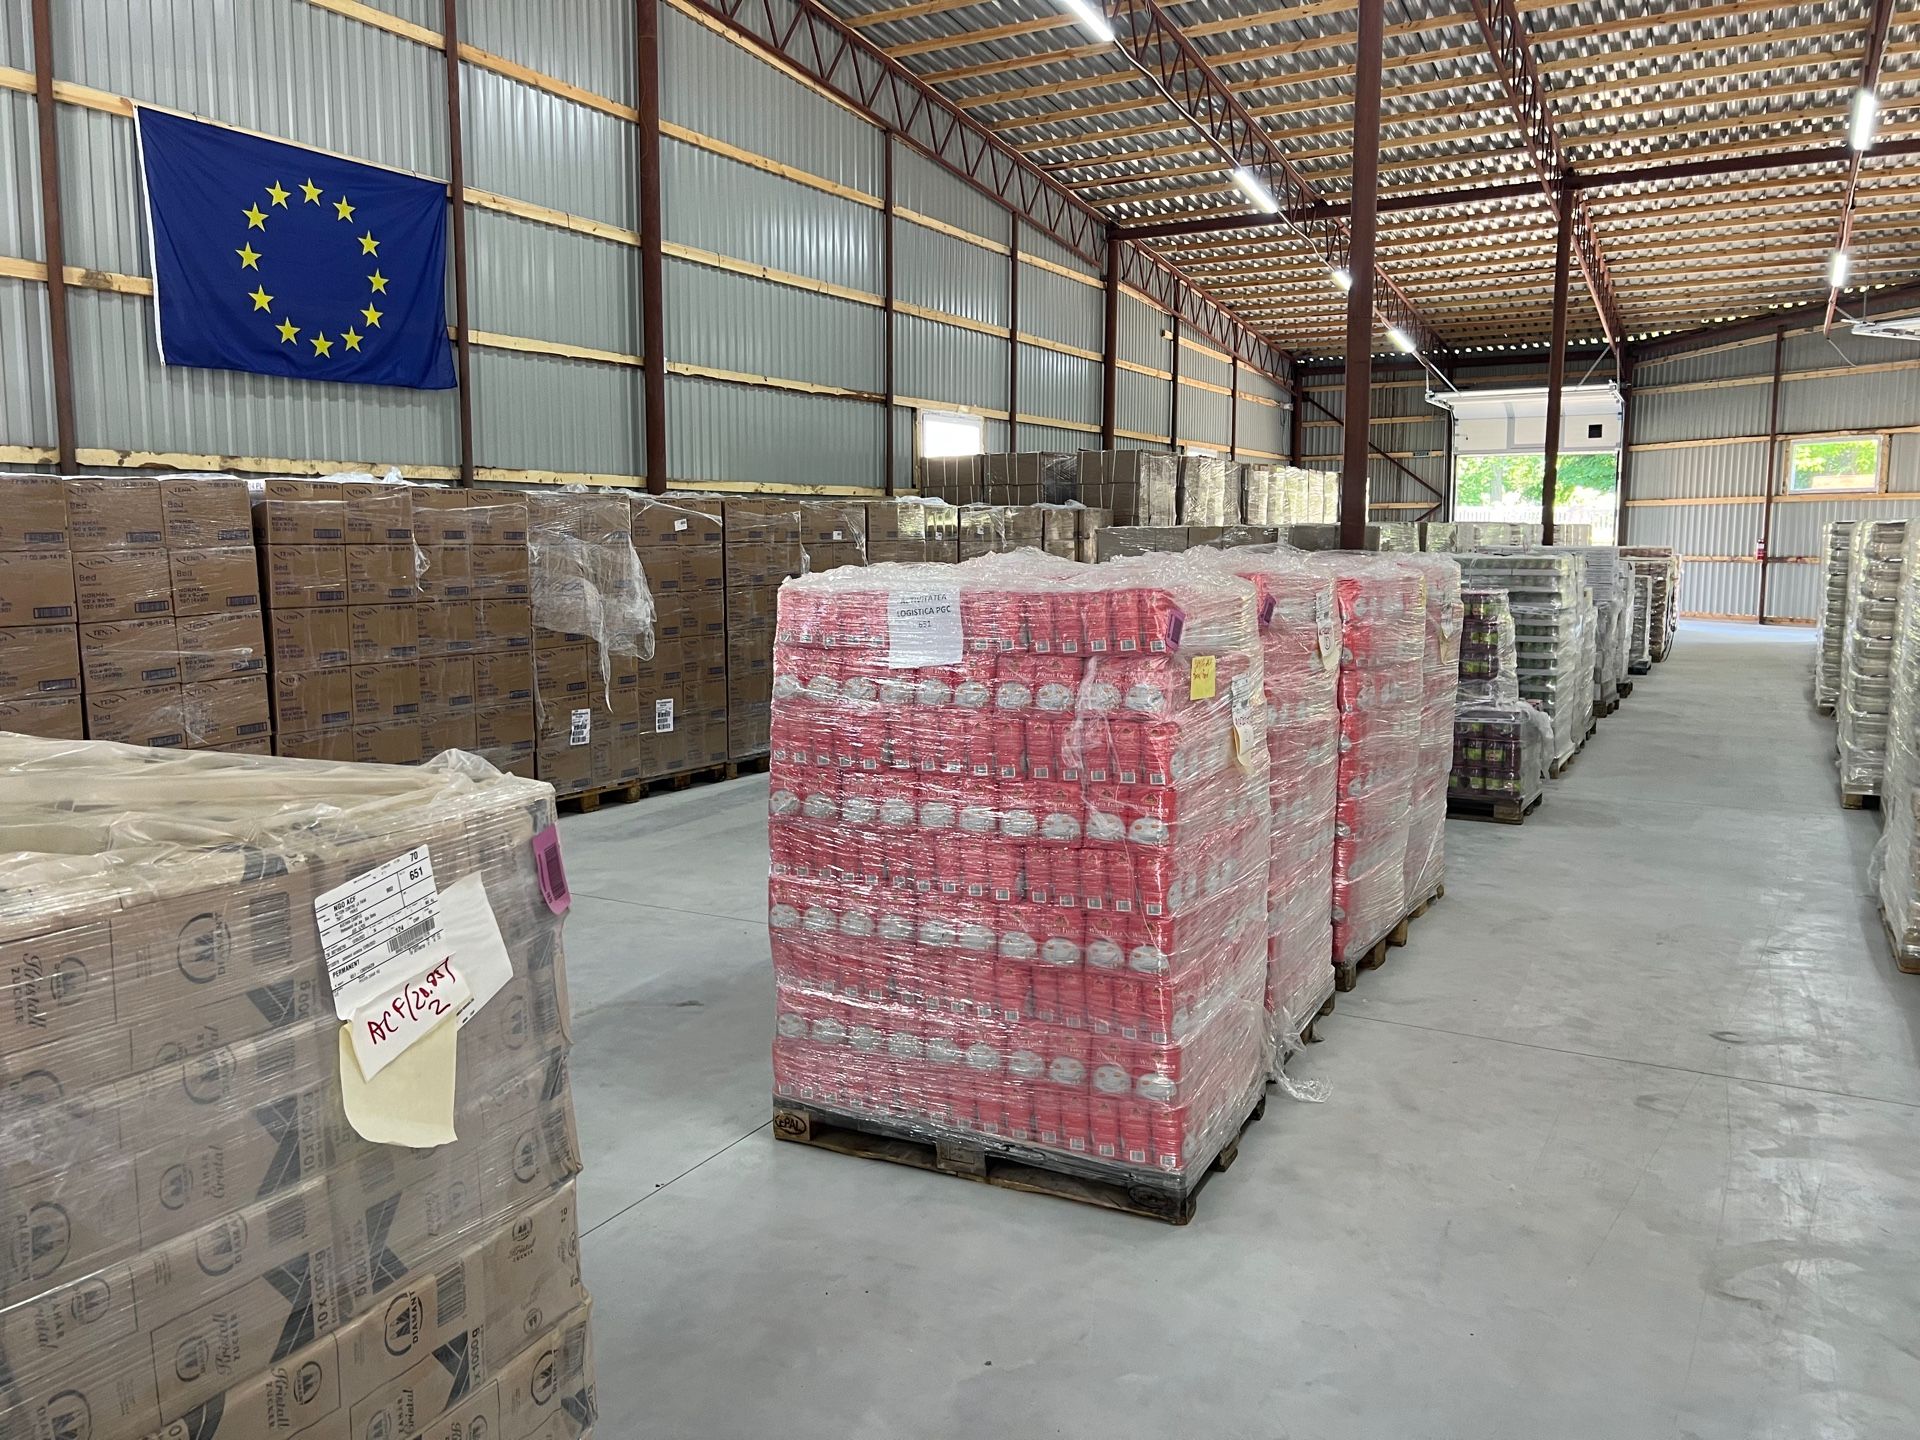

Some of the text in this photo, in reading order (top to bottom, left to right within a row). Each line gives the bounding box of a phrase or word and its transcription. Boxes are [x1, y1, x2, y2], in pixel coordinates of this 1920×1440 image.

[79, 574, 97, 582] Bed
[896, 605, 952, 618] LOGISTICA PGC
[918, 620, 932, 628] 651
[409, 851, 419, 862] 70
[409, 866, 424, 881] 651
[333, 896, 356, 912] NGO ACF
[332, 958, 360, 979] PERMANENT
[11, 967, 24, 1025] ZUCKER
[428, 998, 451, 1016] 2
[367, 997, 405, 1045] ACF
[314, 1250, 326, 1262] g
[318, 1298, 328, 1309] x
[316, 1310, 329, 1330] 10
[408, 1290, 420, 1345] DIAMANT
[472, 1327, 480, 1338] g
[266, 1382, 275, 1428] ZUCKER
[270, 1367, 290, 1430] Kristall
